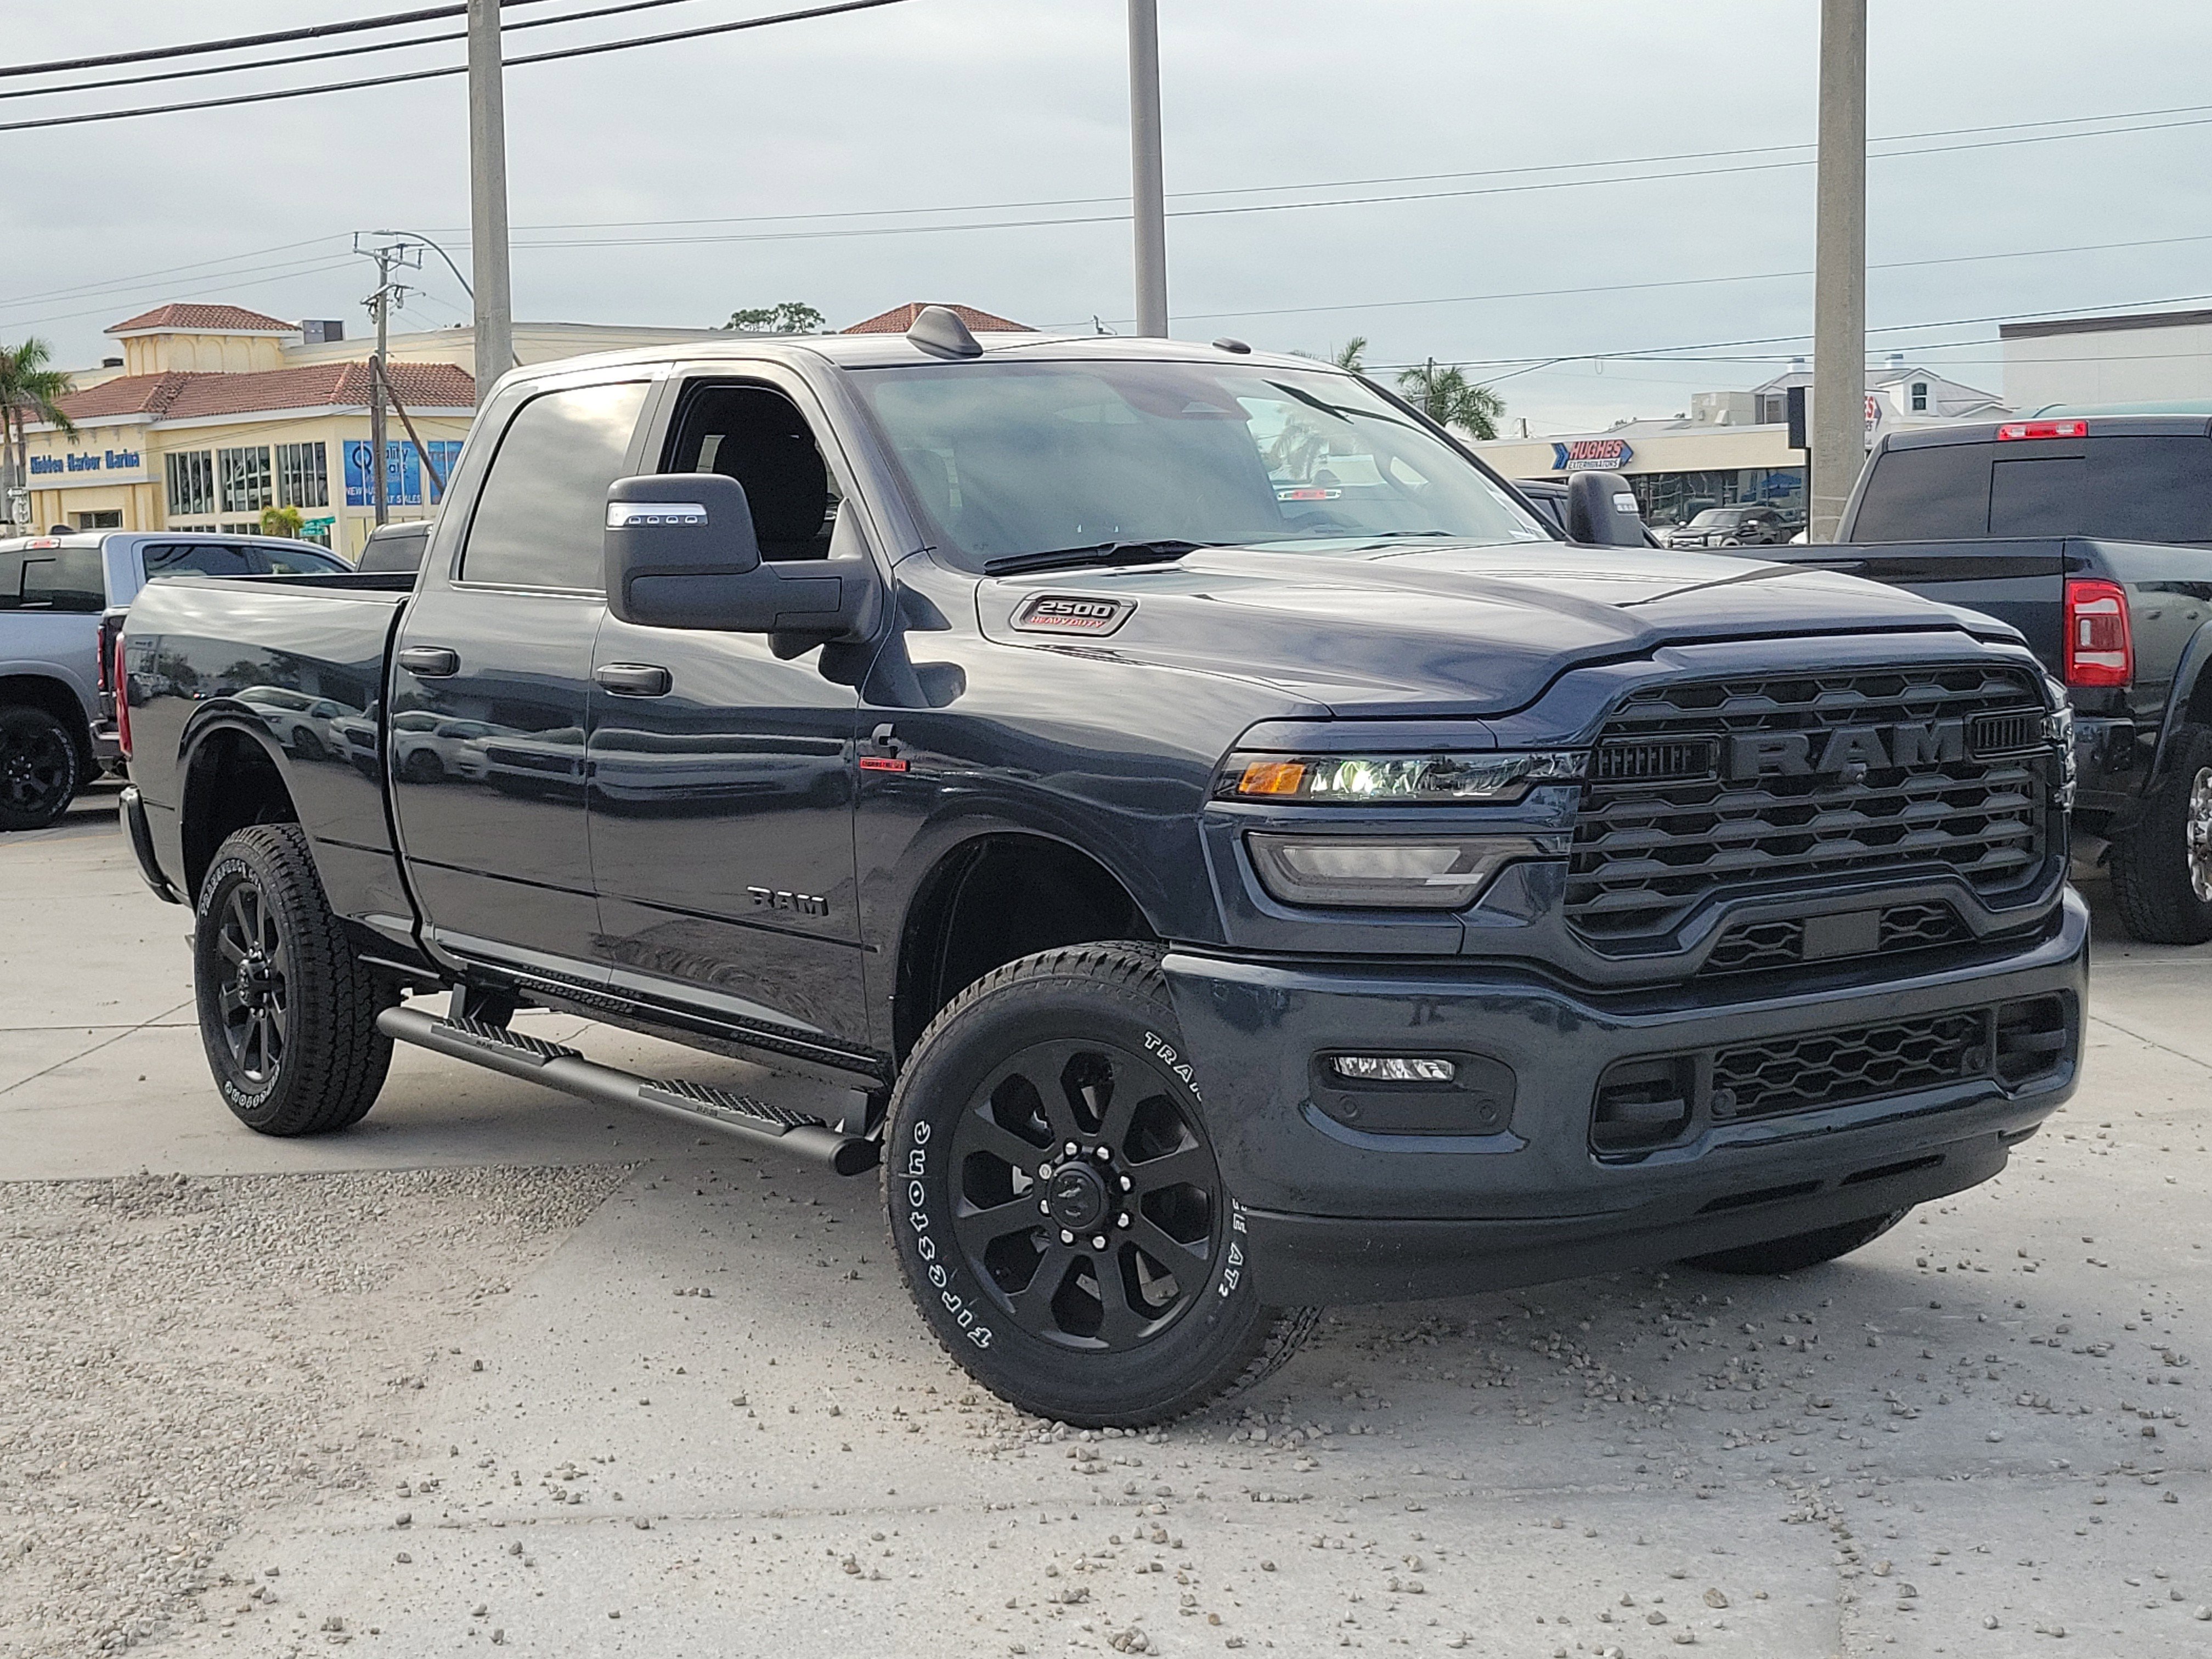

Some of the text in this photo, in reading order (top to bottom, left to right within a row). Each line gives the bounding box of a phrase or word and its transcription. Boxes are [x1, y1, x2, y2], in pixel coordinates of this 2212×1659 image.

[67, 452, 101, 471] Harbor
[105, 449, 139, 469] Marina
[352, 445, 409, 474] Qality
[1570, 439, 1623, 459] HUGHES
[1037, 601, 1112, 617] 2500
[1731, 718, 1963, 780] RAM
[747, 885, 829, 916] RAM
[909, 1121, 992, 1348] Firestone
